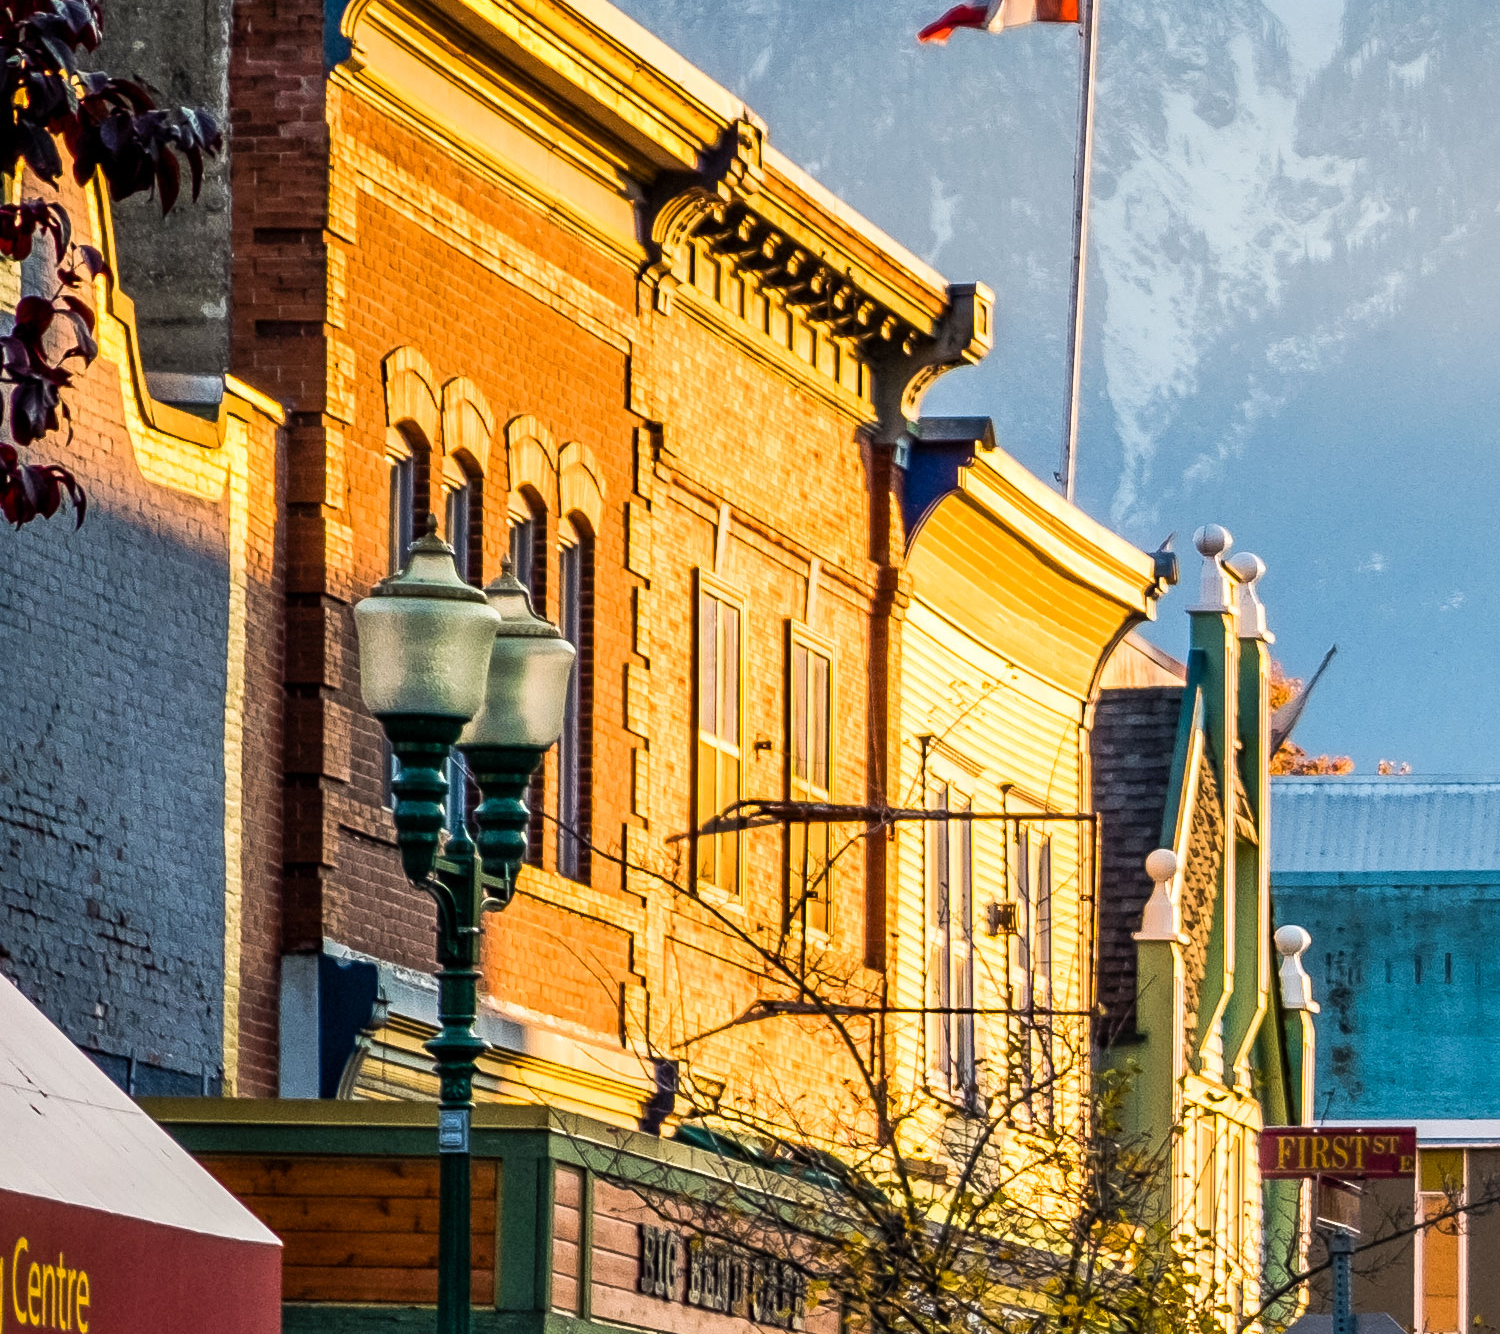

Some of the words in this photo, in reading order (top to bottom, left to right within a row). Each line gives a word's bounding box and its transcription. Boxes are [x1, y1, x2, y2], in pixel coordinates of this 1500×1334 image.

[1275, 1135, 1370, 1170] FIRST
[1372, 1135, 1400, 1154] ST
[1400, 1155, 1414, 1172] E
